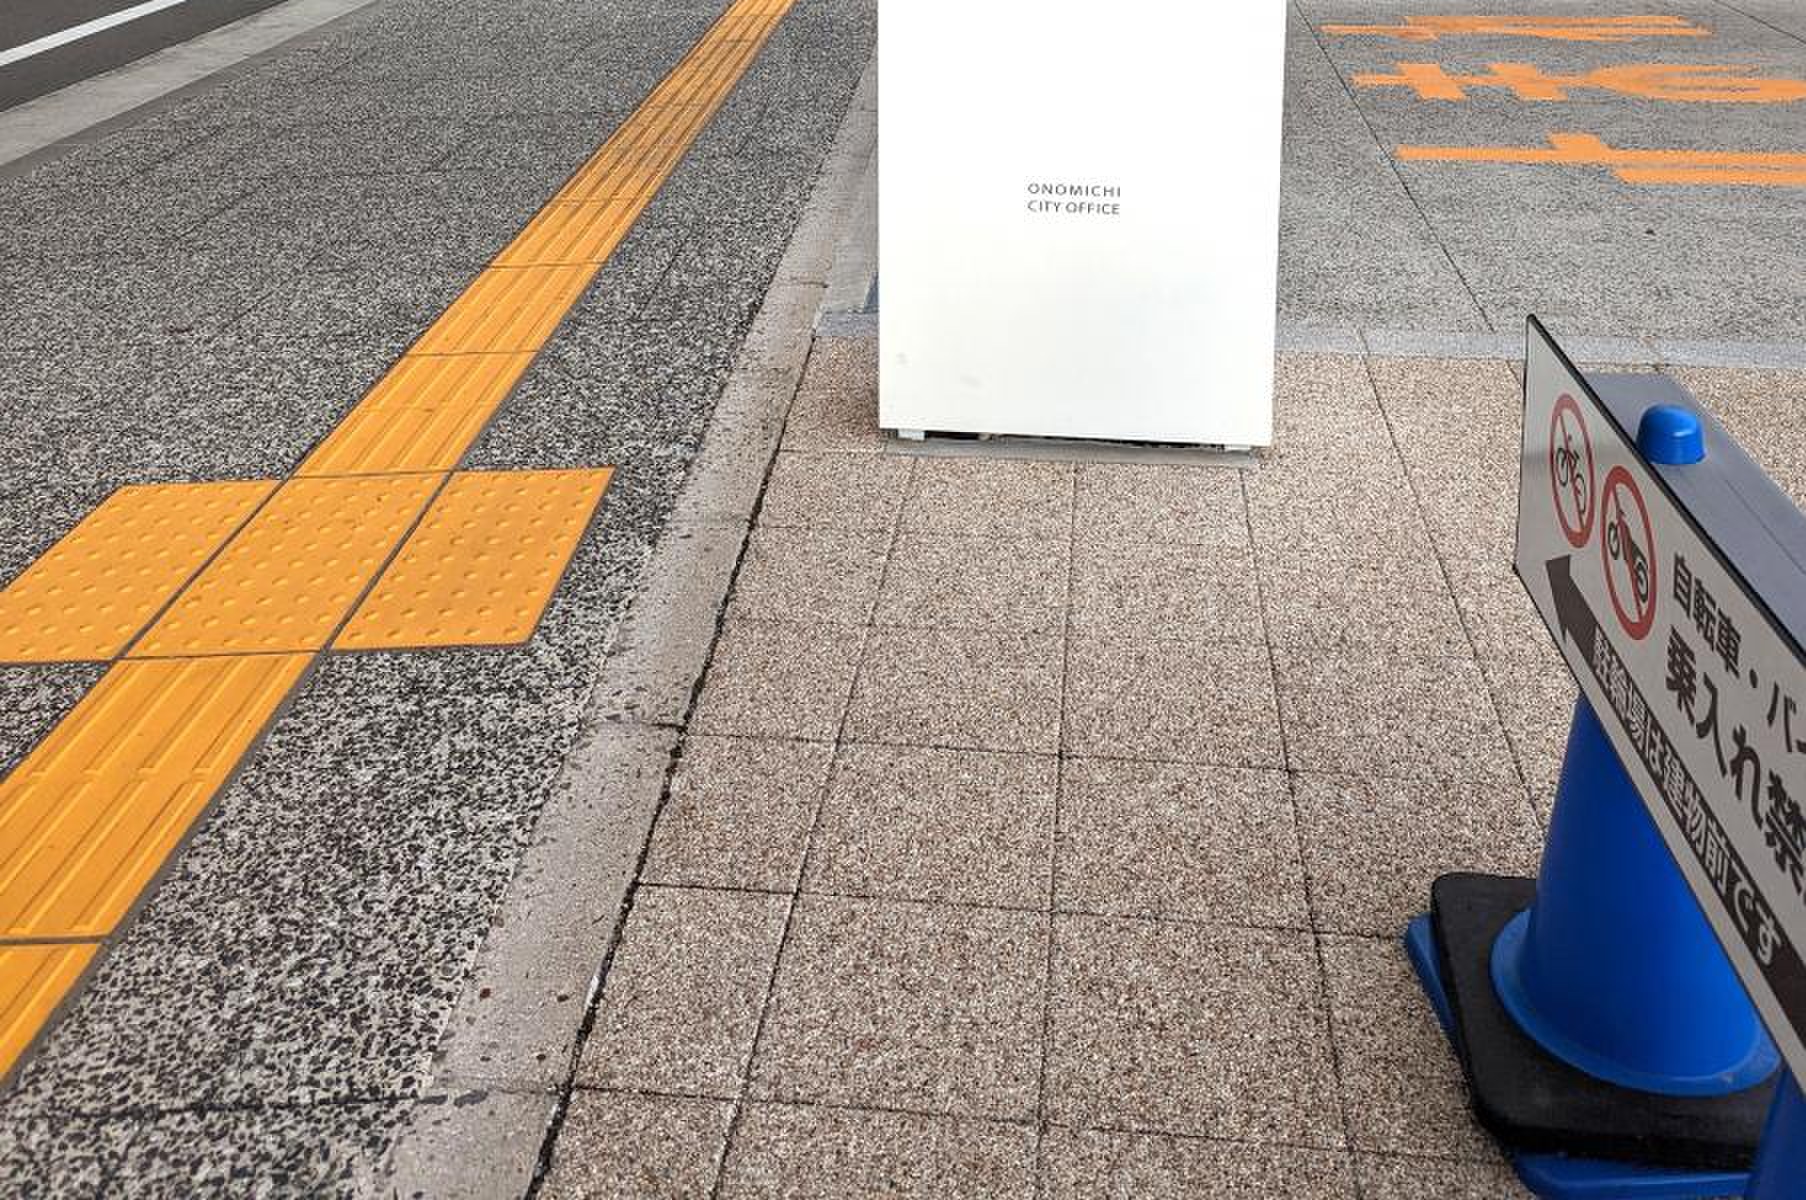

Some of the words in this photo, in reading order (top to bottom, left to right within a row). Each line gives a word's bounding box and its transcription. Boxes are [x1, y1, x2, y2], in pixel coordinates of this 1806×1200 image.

[1028, 184, 1120, 196] ONOMICHI
[1028, 201, 1060, 212] CITY
[1066, 202, 1118, 214] OFFICE
[1665, 624, 1806, 902] 乗入れ禁
